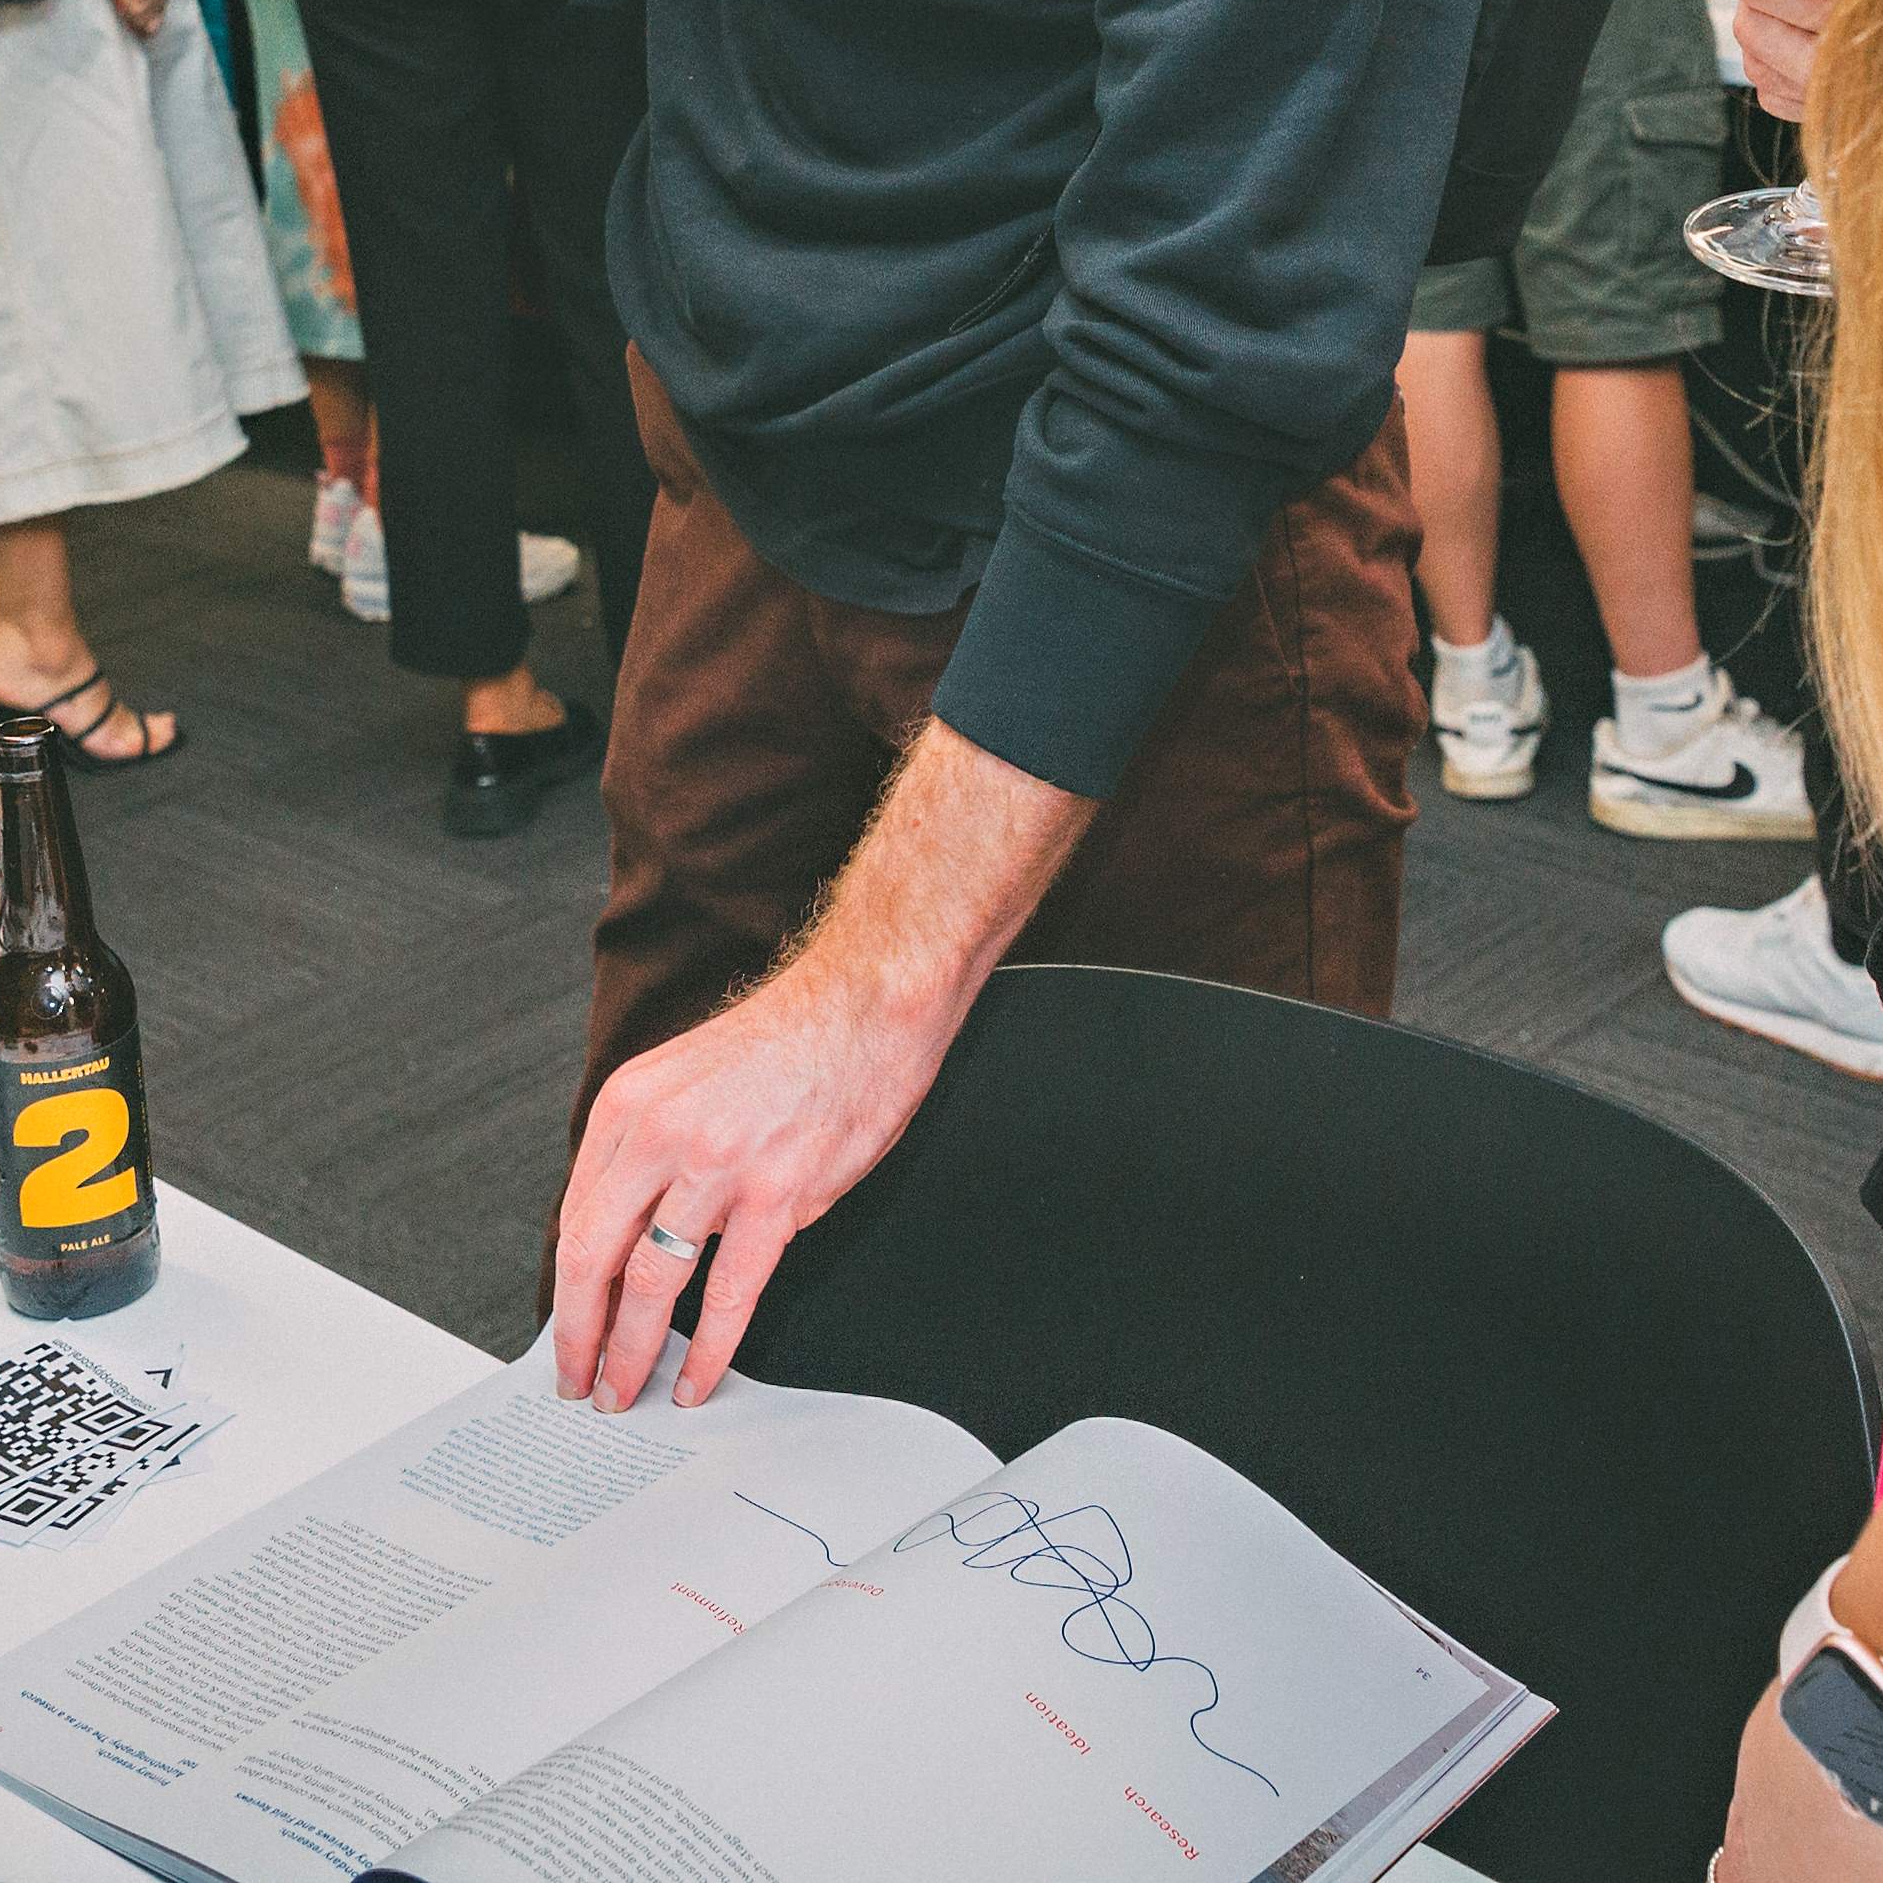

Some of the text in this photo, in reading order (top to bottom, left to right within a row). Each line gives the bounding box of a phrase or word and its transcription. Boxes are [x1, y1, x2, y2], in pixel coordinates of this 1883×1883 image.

[20, 1056, 111, 1086] HALLERTAU
[13, 1087, 139, 1229] 2
[60, 1233, 112, 1253] PALE ALE
[670, 1581, 748, 1637] Refinment
[1415, 1666, 1433, 1681] 34
[20, 1690, 57, 1713] research
[63, 1714, 76, 1723] as
[1024, 1691, 1092, 1756] Ideation
[91, 1730, 108, 1743] The
[467, 1764, 497, 1789] ntexts.
[234, 1792, 373, 1867] ory Reviews and Field Reviews
[1123, 1783, 1200, 1863] Research
[367, 1823, 402, 1852] ondary
[322, 1850, 359, 1877] ondary
[592, 1848, 634, 1883] esearch
[752, 1861, 774, 1881] ach
